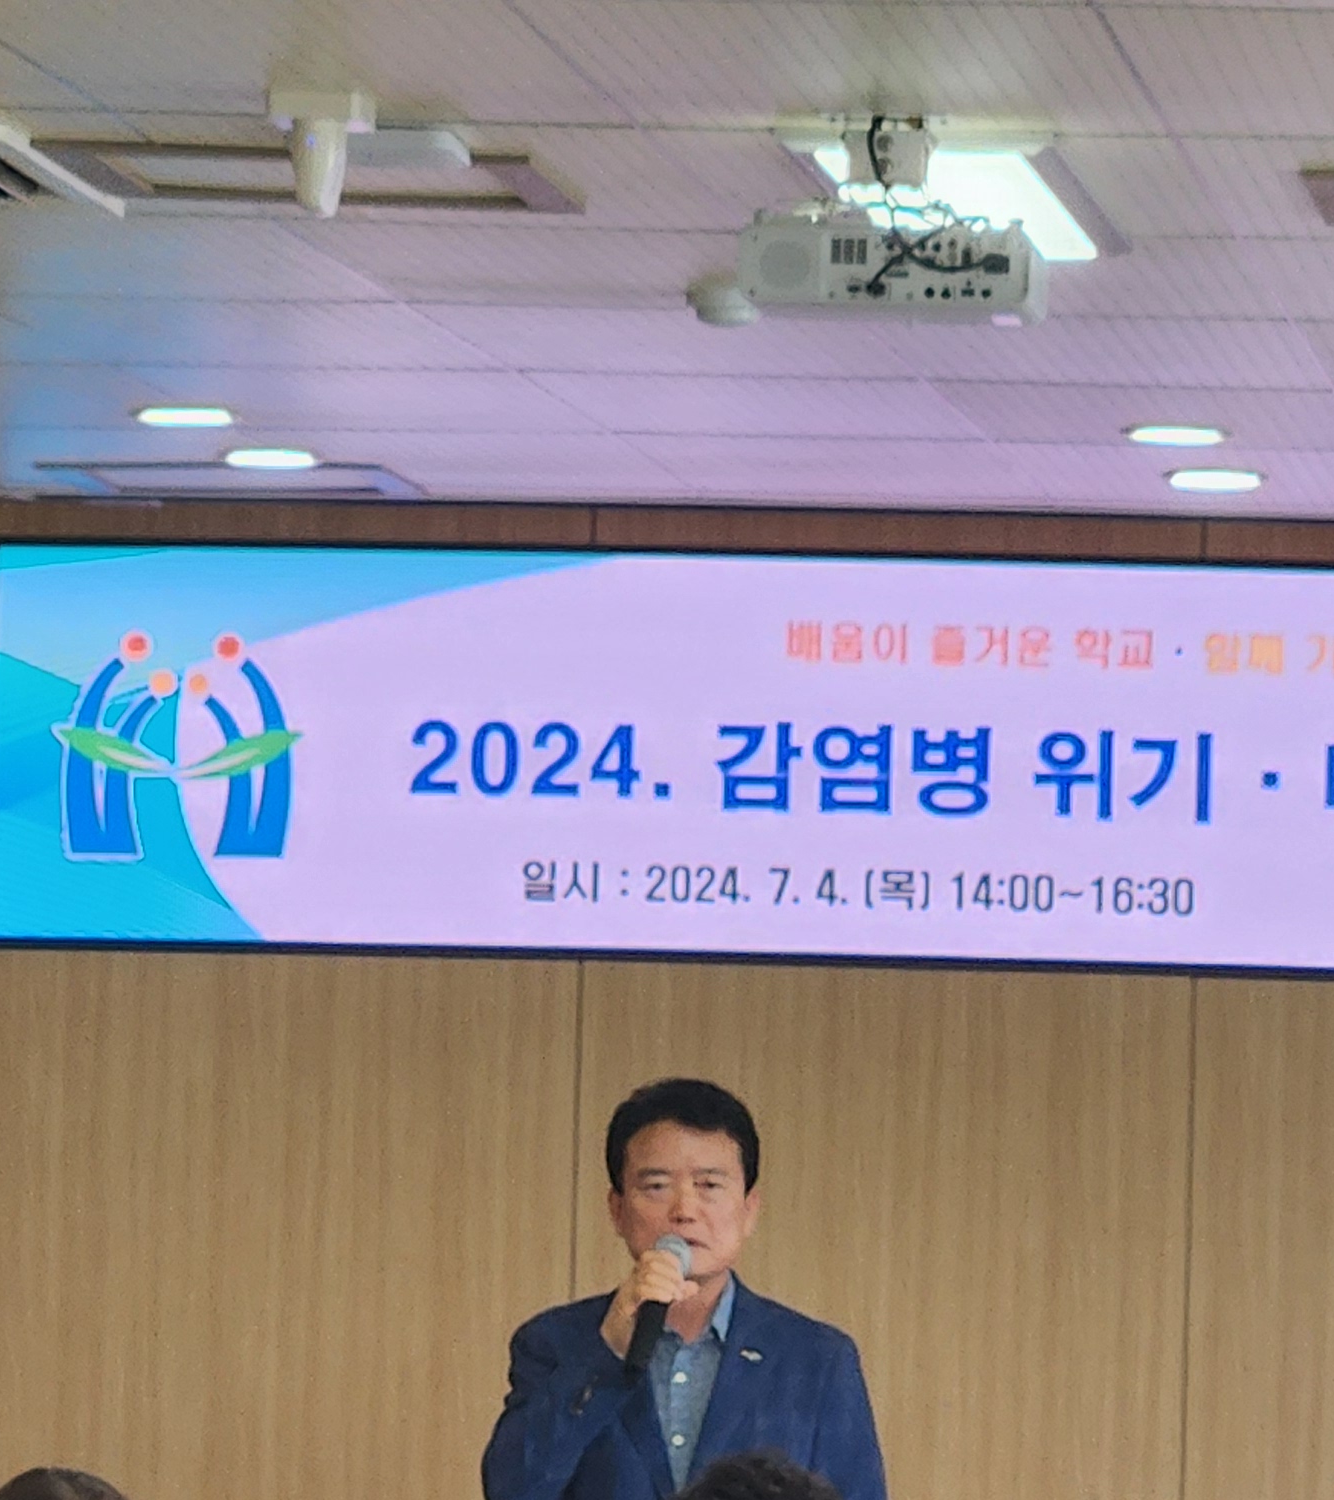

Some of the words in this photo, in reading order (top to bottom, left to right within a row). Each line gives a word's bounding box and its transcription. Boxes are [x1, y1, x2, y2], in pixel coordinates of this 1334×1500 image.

[785, 621, 910, 667] 배움이
[930, 625, 1053, 670] 즐거운
[1073, 628, 1155, 671] 학교
[410, 719, 673, 802] 2024.
[716, 721, 994, 820] 감염병
[1033, 729, 1215, 827] 위기
[522, 860, 602, 905] 일시
[645, 864, 753, 906] 2024.
[768, 867, 803, 908] 7.
[816, 868, 850, 909] 4.
[864, 867, 932, 913] (목)
[952, 871, 1196, 919] 14:00~16:30
